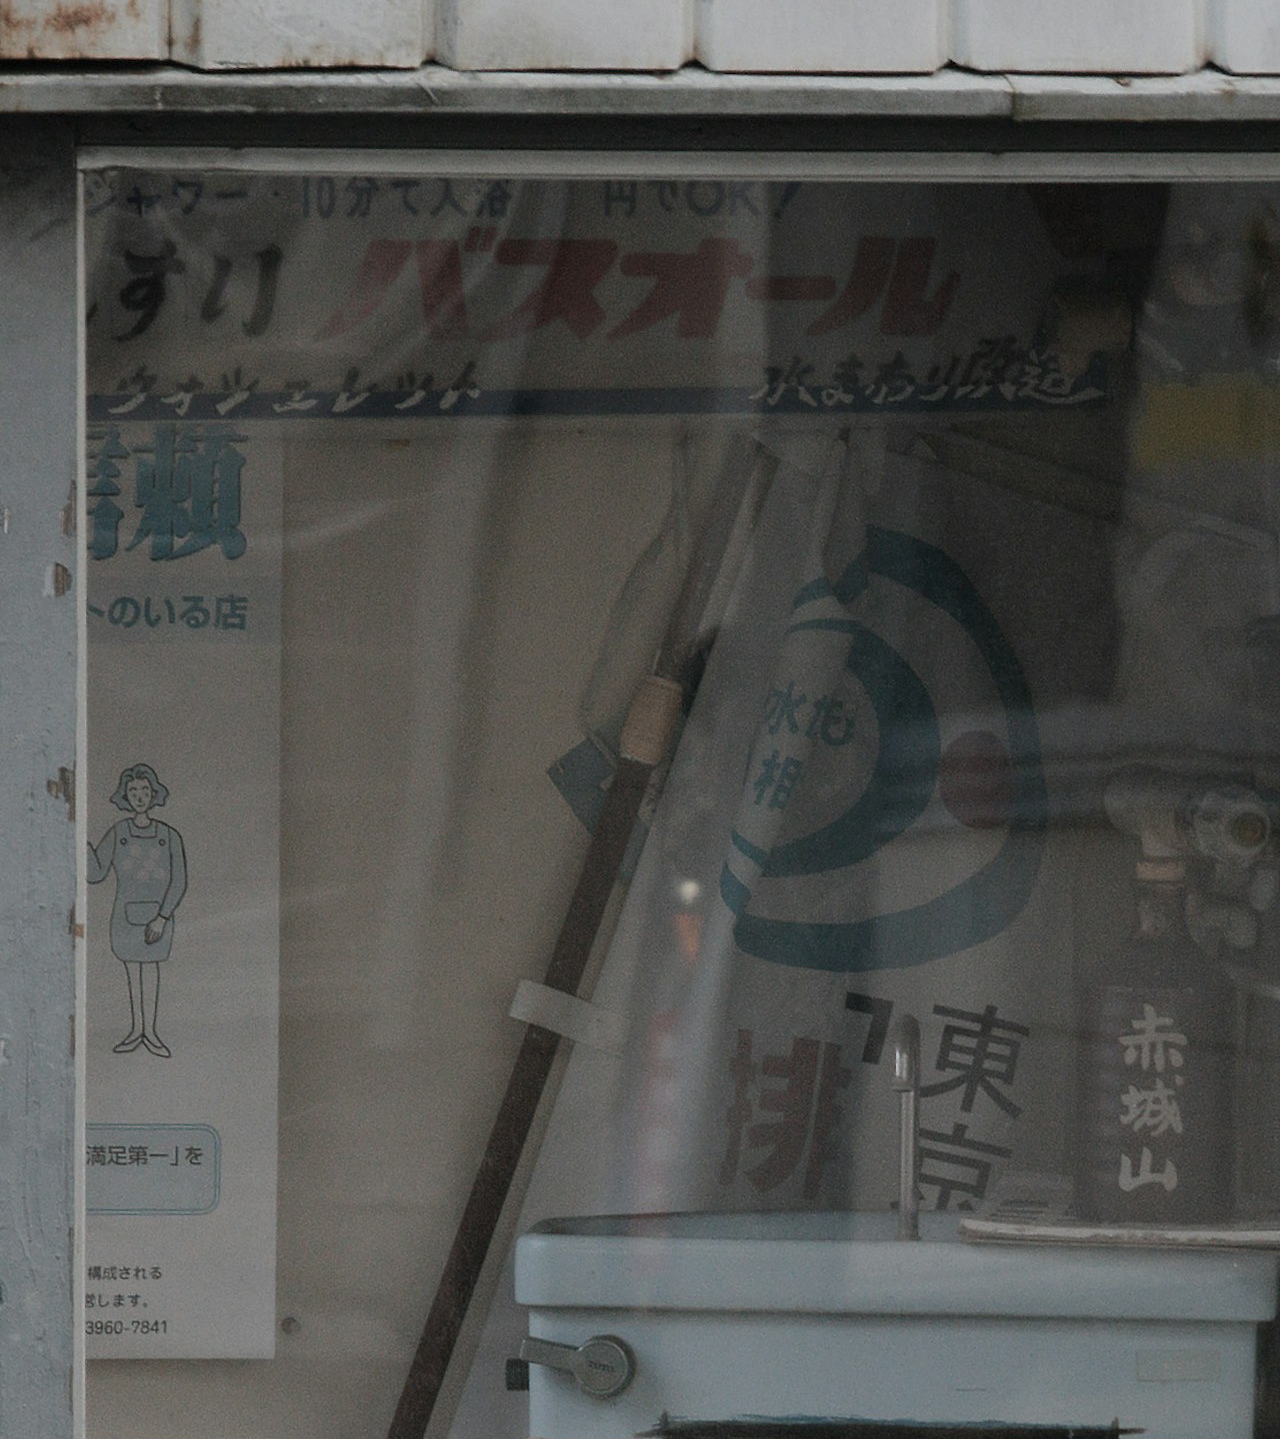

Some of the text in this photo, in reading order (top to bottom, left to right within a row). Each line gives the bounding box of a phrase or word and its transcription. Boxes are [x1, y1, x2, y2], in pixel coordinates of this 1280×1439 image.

[87, 225, 960, 340] すり バスオール
[1118, 1002, 1189, 1192] 赤城山
[87, 1265, 163, 1281] 構成される
